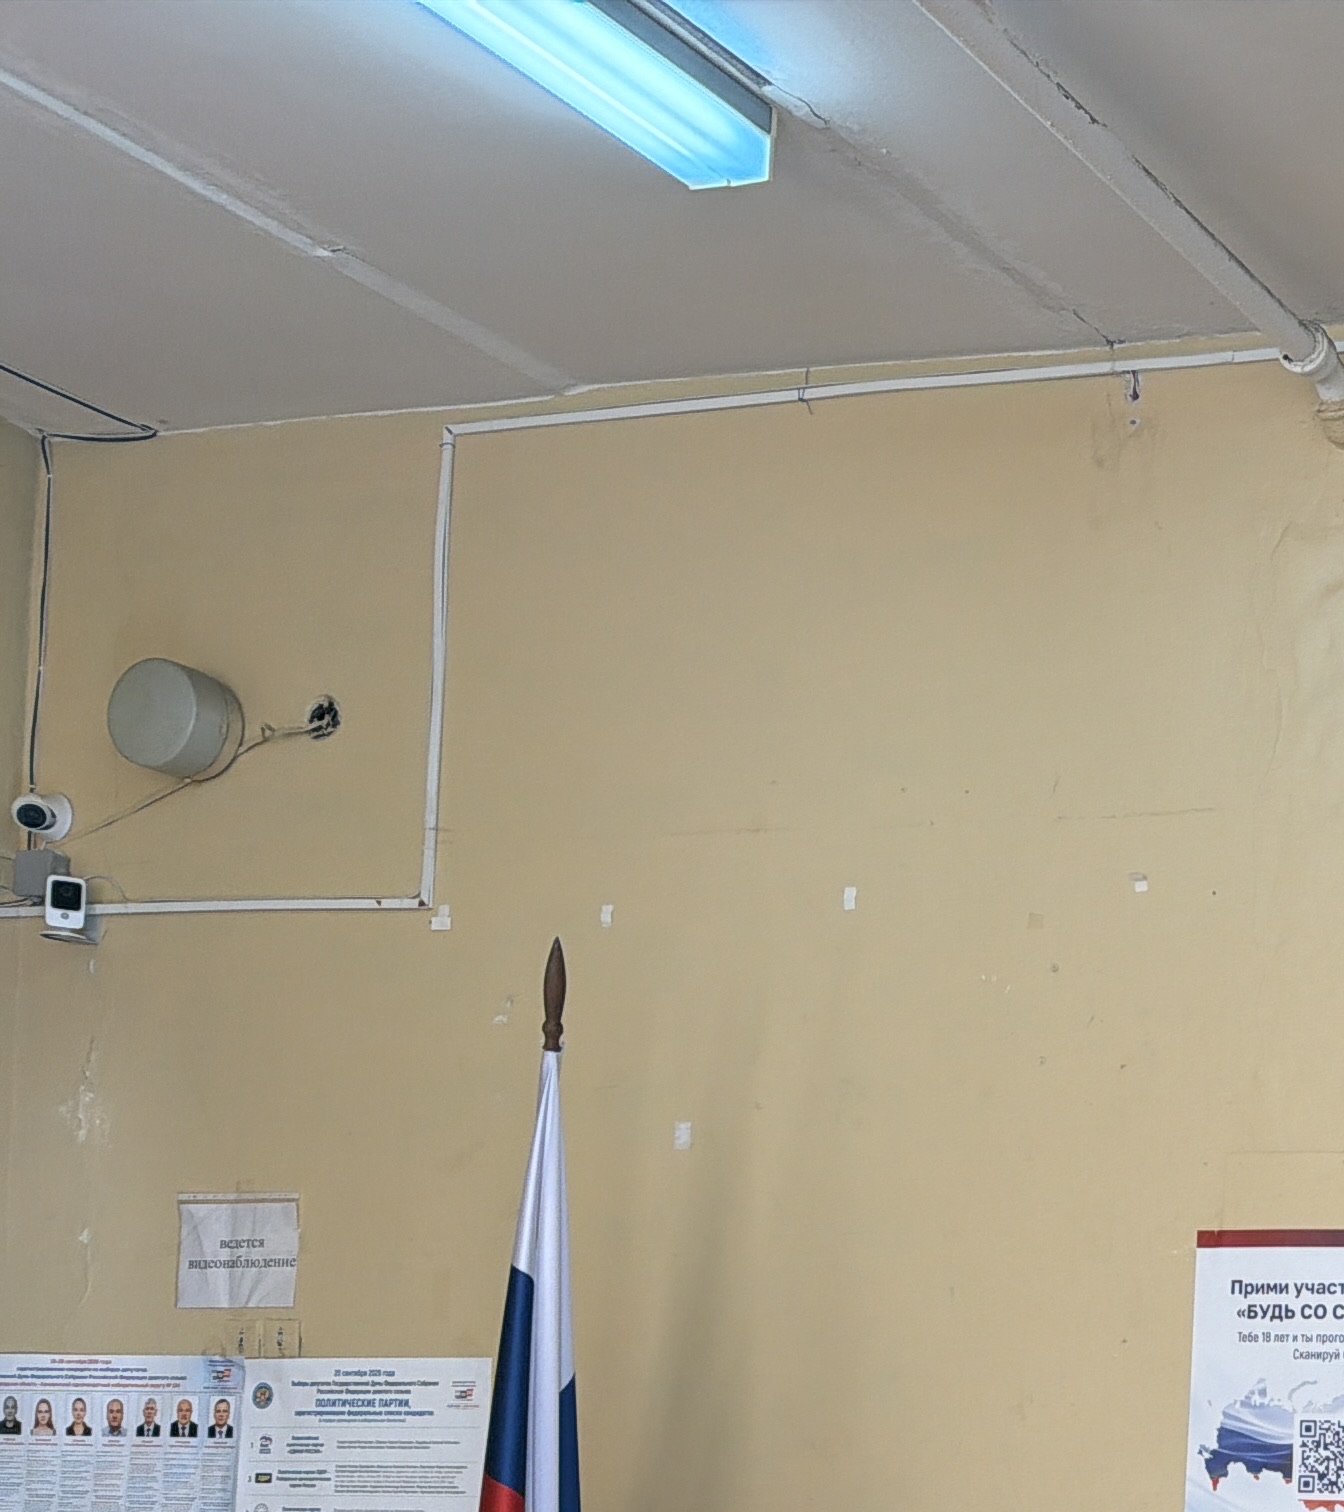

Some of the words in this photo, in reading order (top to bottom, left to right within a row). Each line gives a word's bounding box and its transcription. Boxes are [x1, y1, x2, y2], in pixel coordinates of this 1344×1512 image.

[219, 1238, 265, 1250] ведется
[188, 1255, 297, 1270] видеонаблюдение
[1230, 1279, 1290, 1299] Прими
[1236, 1303, 1296, 1323] «БУДЬ
[1300, 1304, 1328, 1320] СО
[1238, 1331, 1260, 1344] Тебе
[1262, 1331, 1272, 1344] 18
[1273, 1333, 1290, 1344] лет
[1292, 1333, 1299, 1344] и
[1301, 1333, 1313, 1344] ты
[1293, 1348, 1341, 1363] Сканируй
